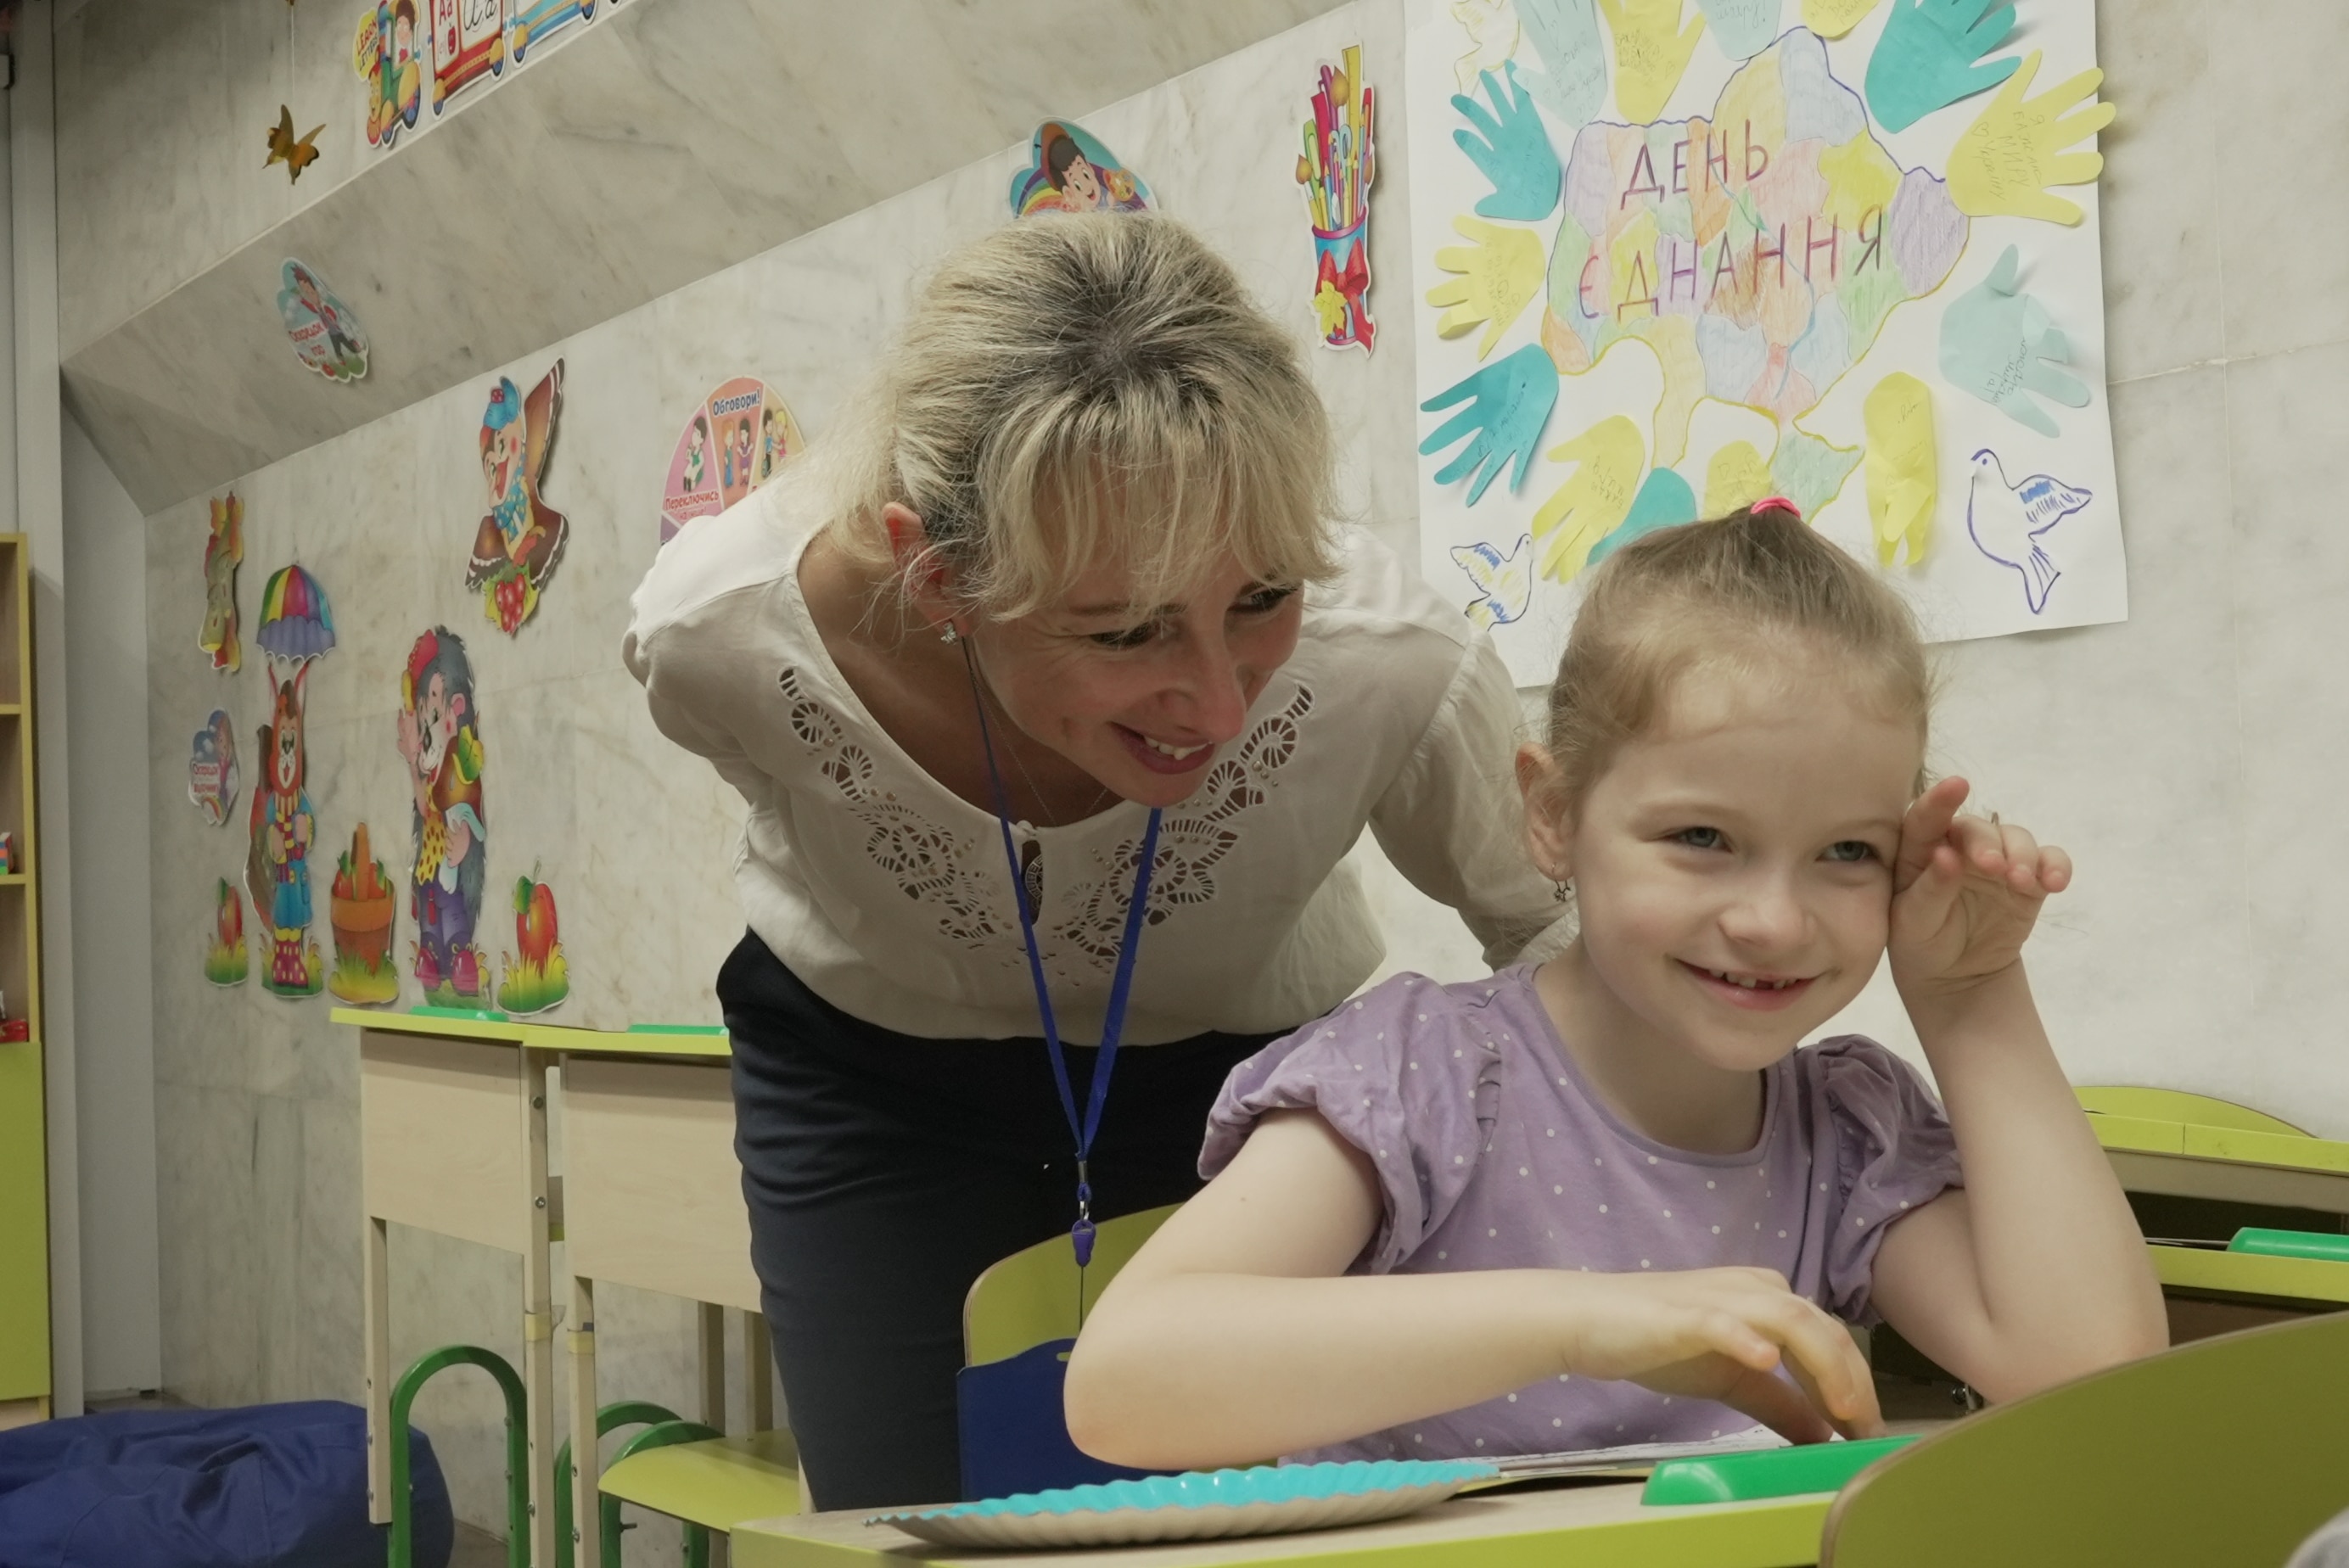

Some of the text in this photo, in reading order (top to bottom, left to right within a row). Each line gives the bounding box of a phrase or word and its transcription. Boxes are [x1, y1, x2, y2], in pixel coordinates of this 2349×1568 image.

[1620, 118, 1769, 210] ДЕНЬ
[1579, 203, 1883, 324] ЄДНАННЯ
[713, 389, 760, 416] Обговори!
[665, 490, 720, 511] Переключись
